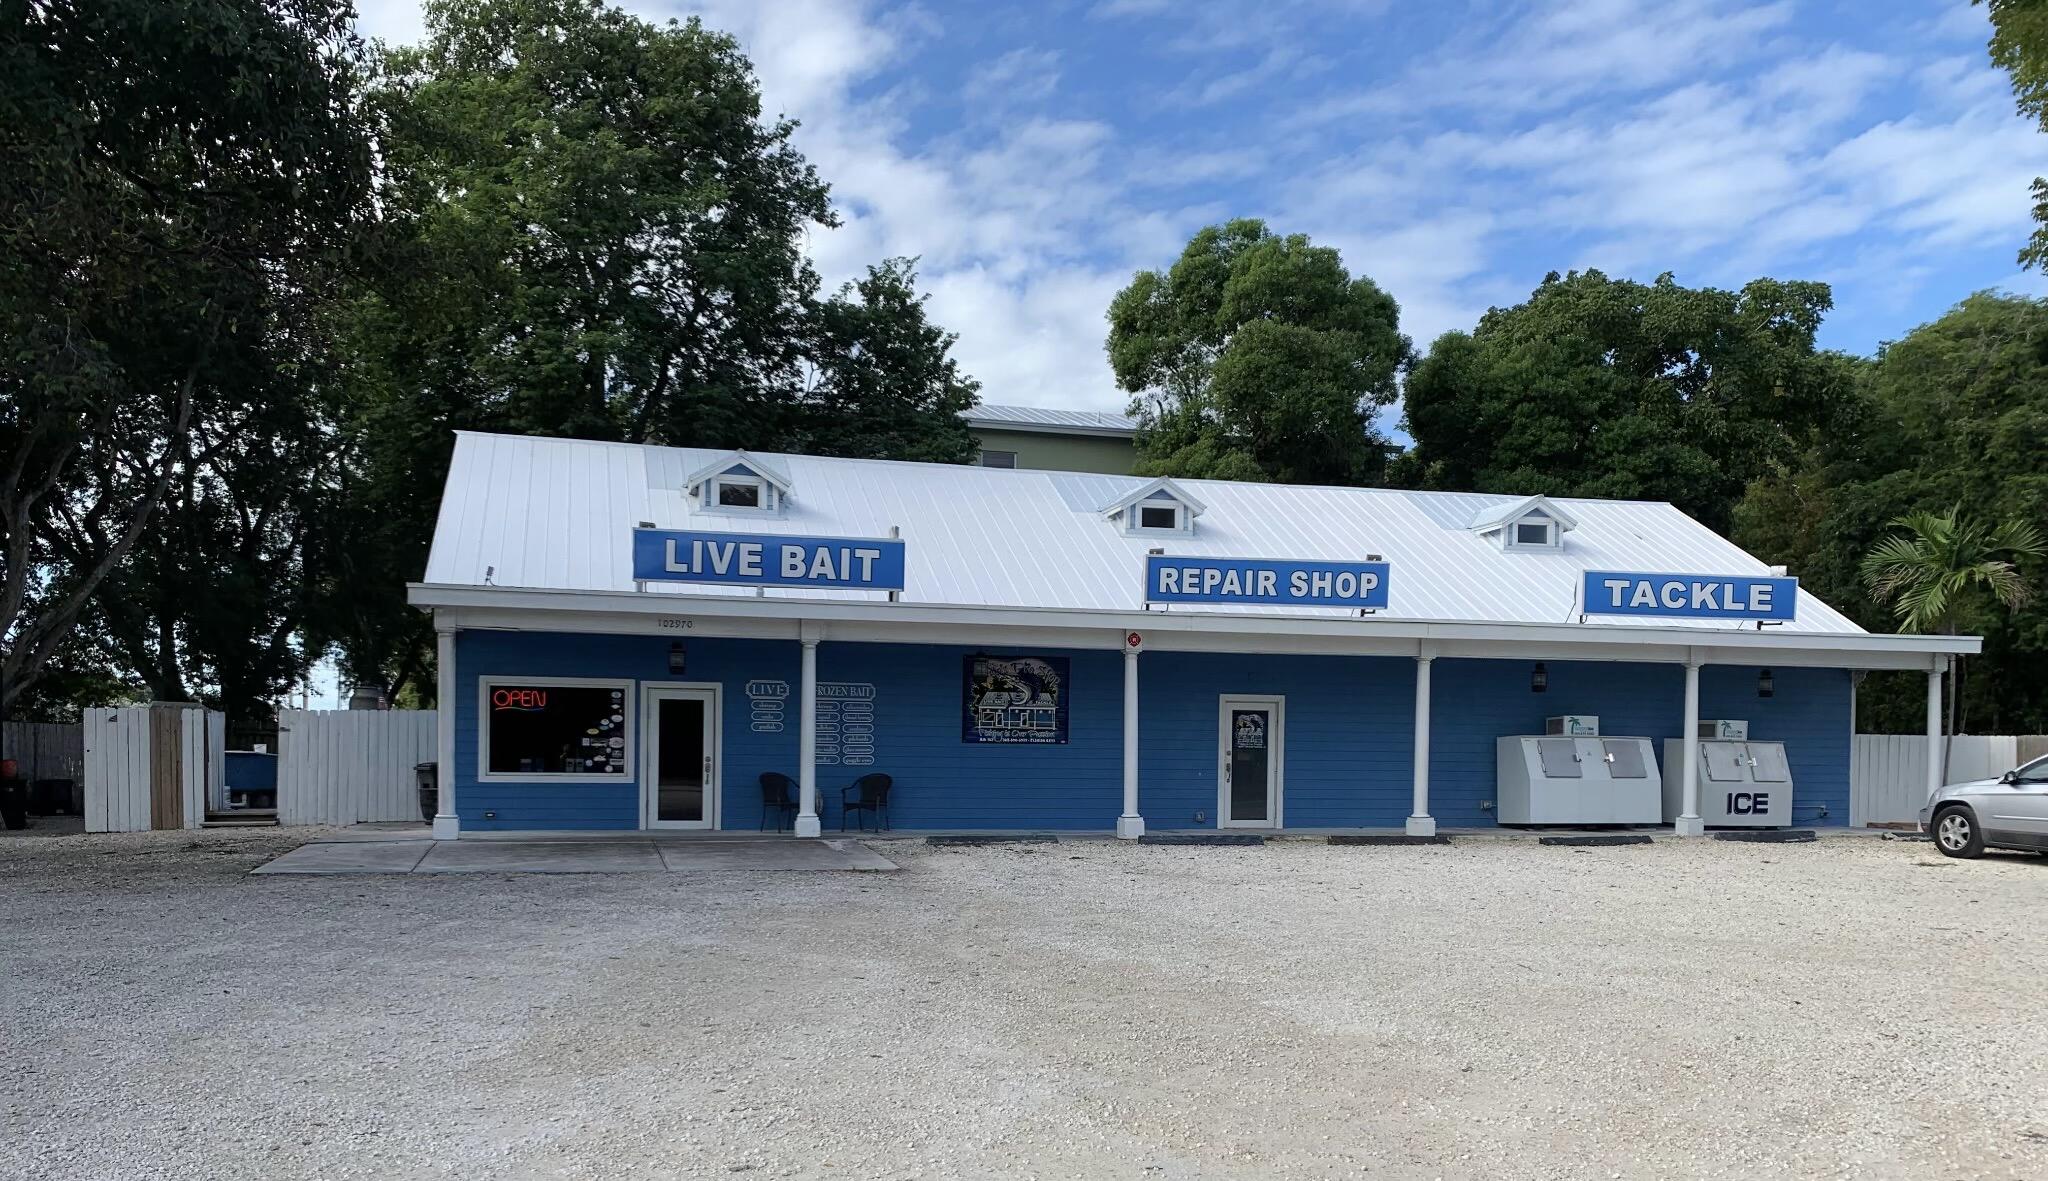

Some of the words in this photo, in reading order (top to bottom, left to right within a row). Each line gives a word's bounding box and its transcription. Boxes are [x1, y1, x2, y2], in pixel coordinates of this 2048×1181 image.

[665, 539, 763, 577] LIVE
[781, 545, 880, 582] BAIT
[1159, 567, 1277, 597] REPAIR
[1290, 570, 1379, 599] SHOP
[1604, 579, 1773, 612] TACKLE
[658, 618, 693, 629] 102970
[493, 690, 546, 707] OPEN
[752, 684, 785, 695] LIVE
[816, 685, 848, 696] ROZEN
[850, 686, 870, 697] BAIT
[1727, 792, 1769, 815] ICE
